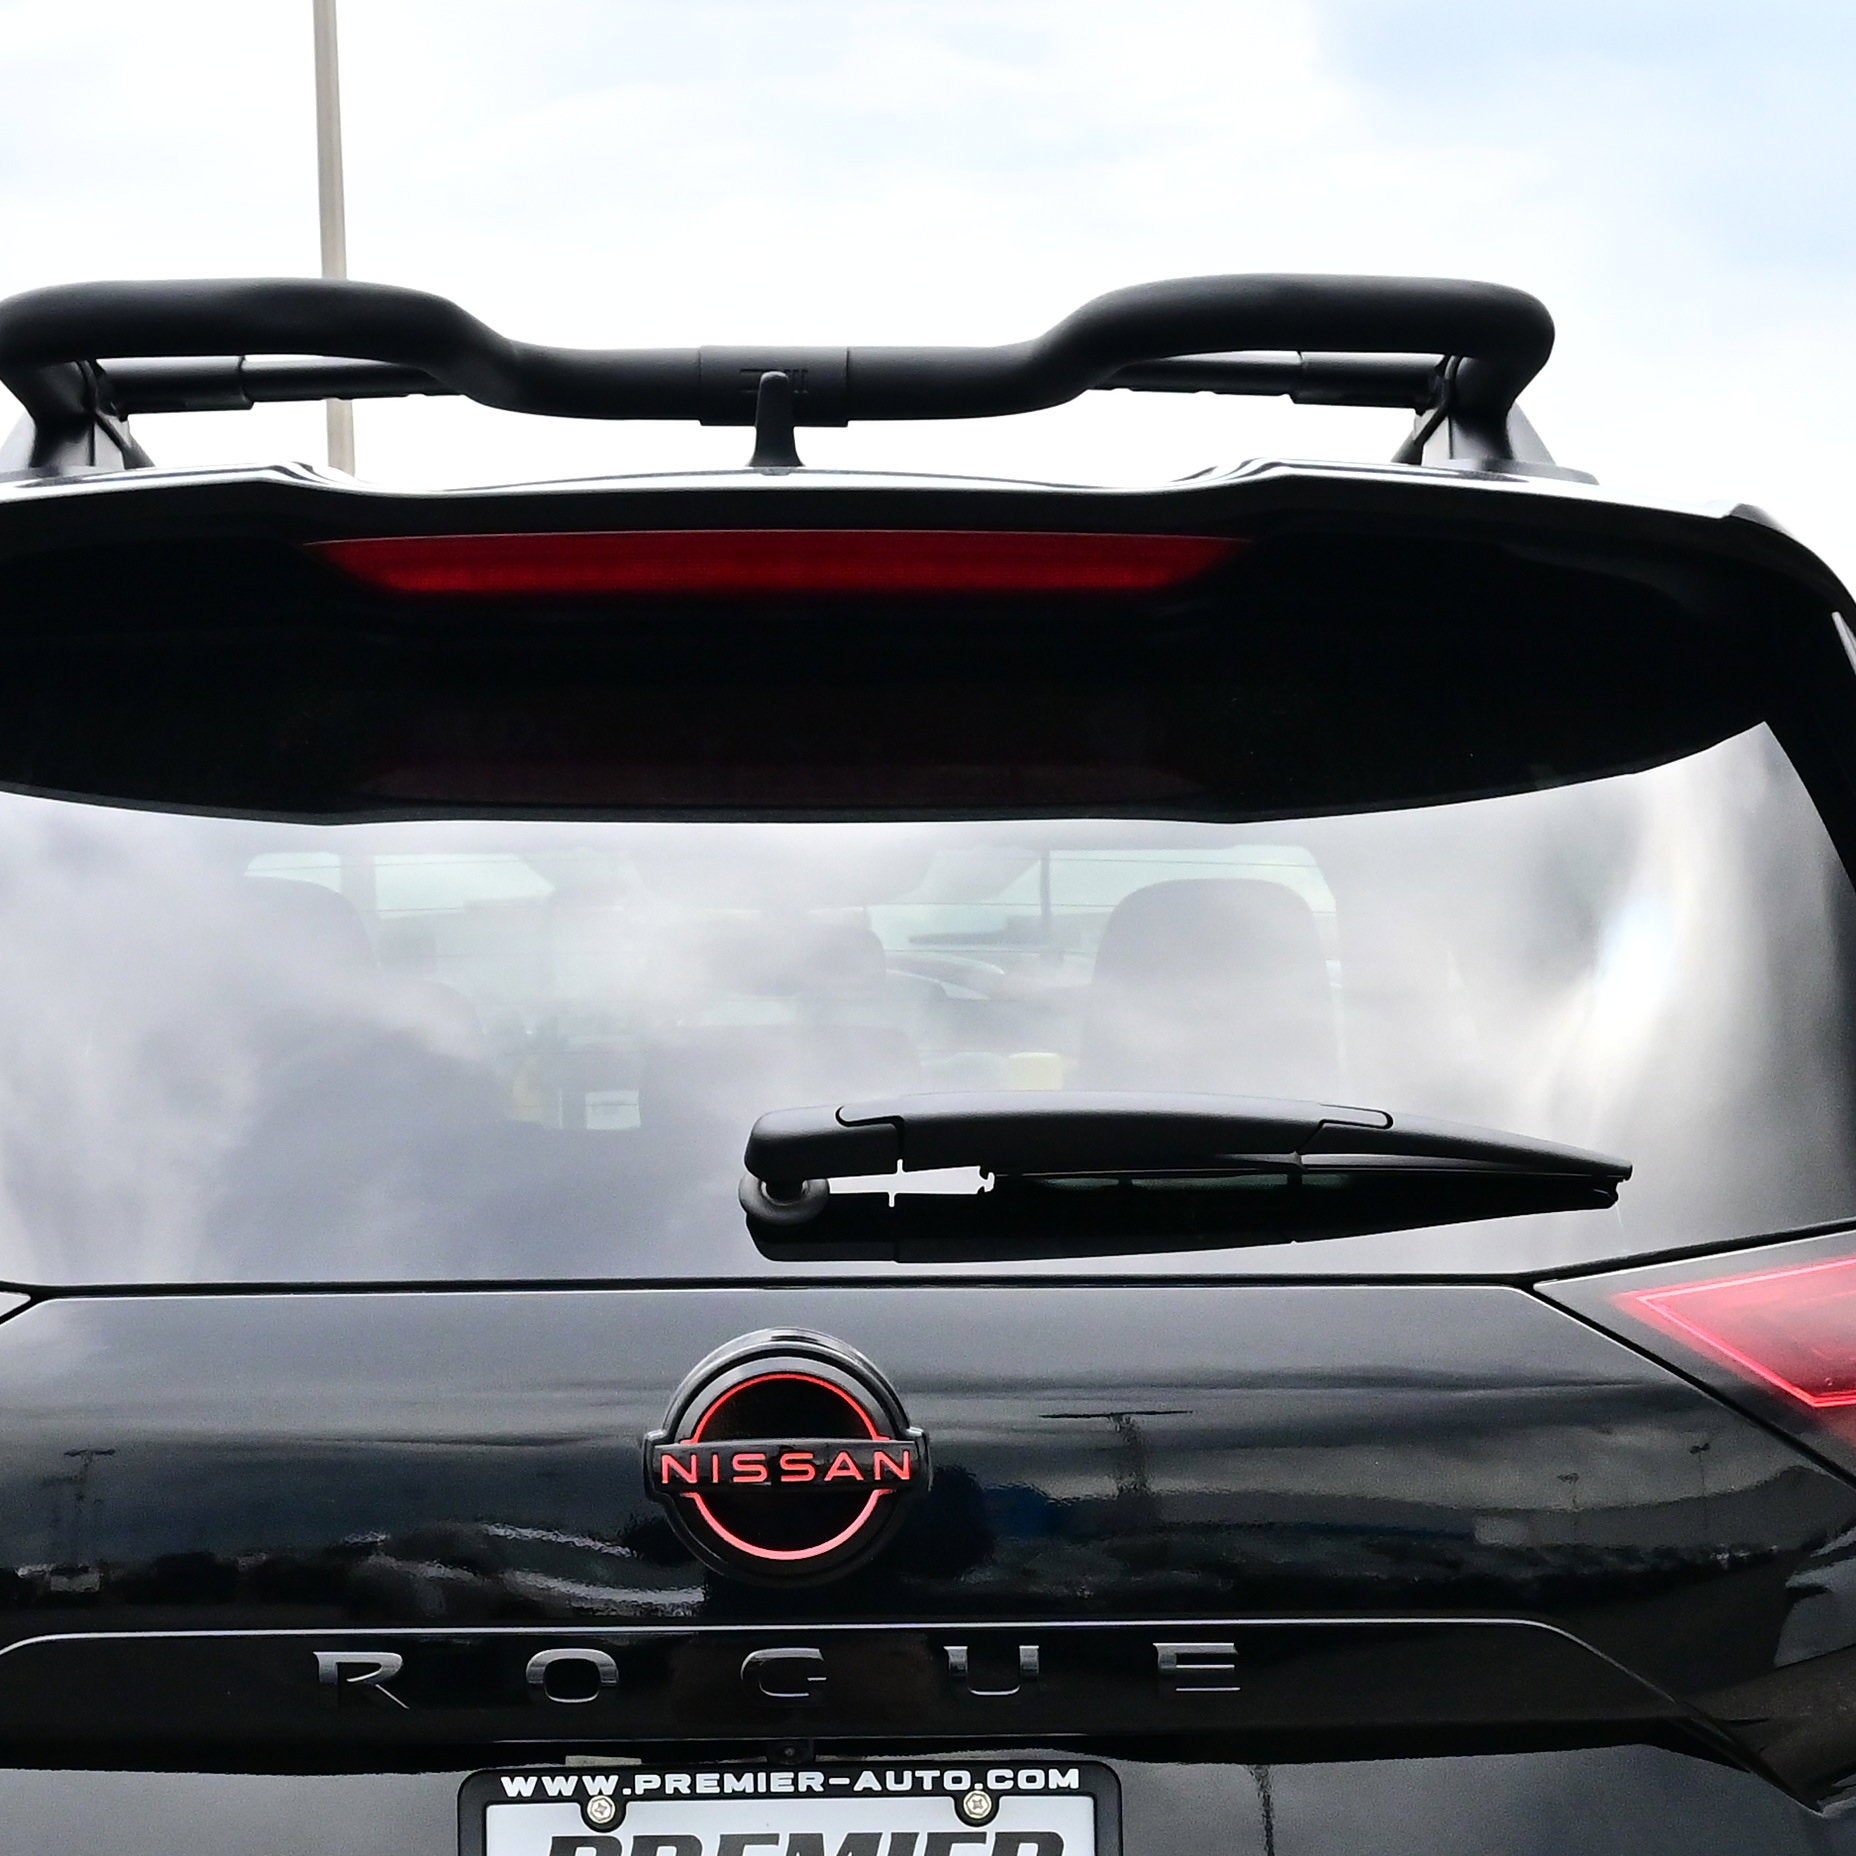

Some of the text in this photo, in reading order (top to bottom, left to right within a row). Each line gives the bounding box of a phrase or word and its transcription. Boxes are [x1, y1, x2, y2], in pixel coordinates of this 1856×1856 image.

[661, 1450, 911, 1484] NISSAN
[312, 1642, 1241, 1710] ROGUE
[501, 1768, 1080, 1797] WWW.PREMIER-AUTO.COM
